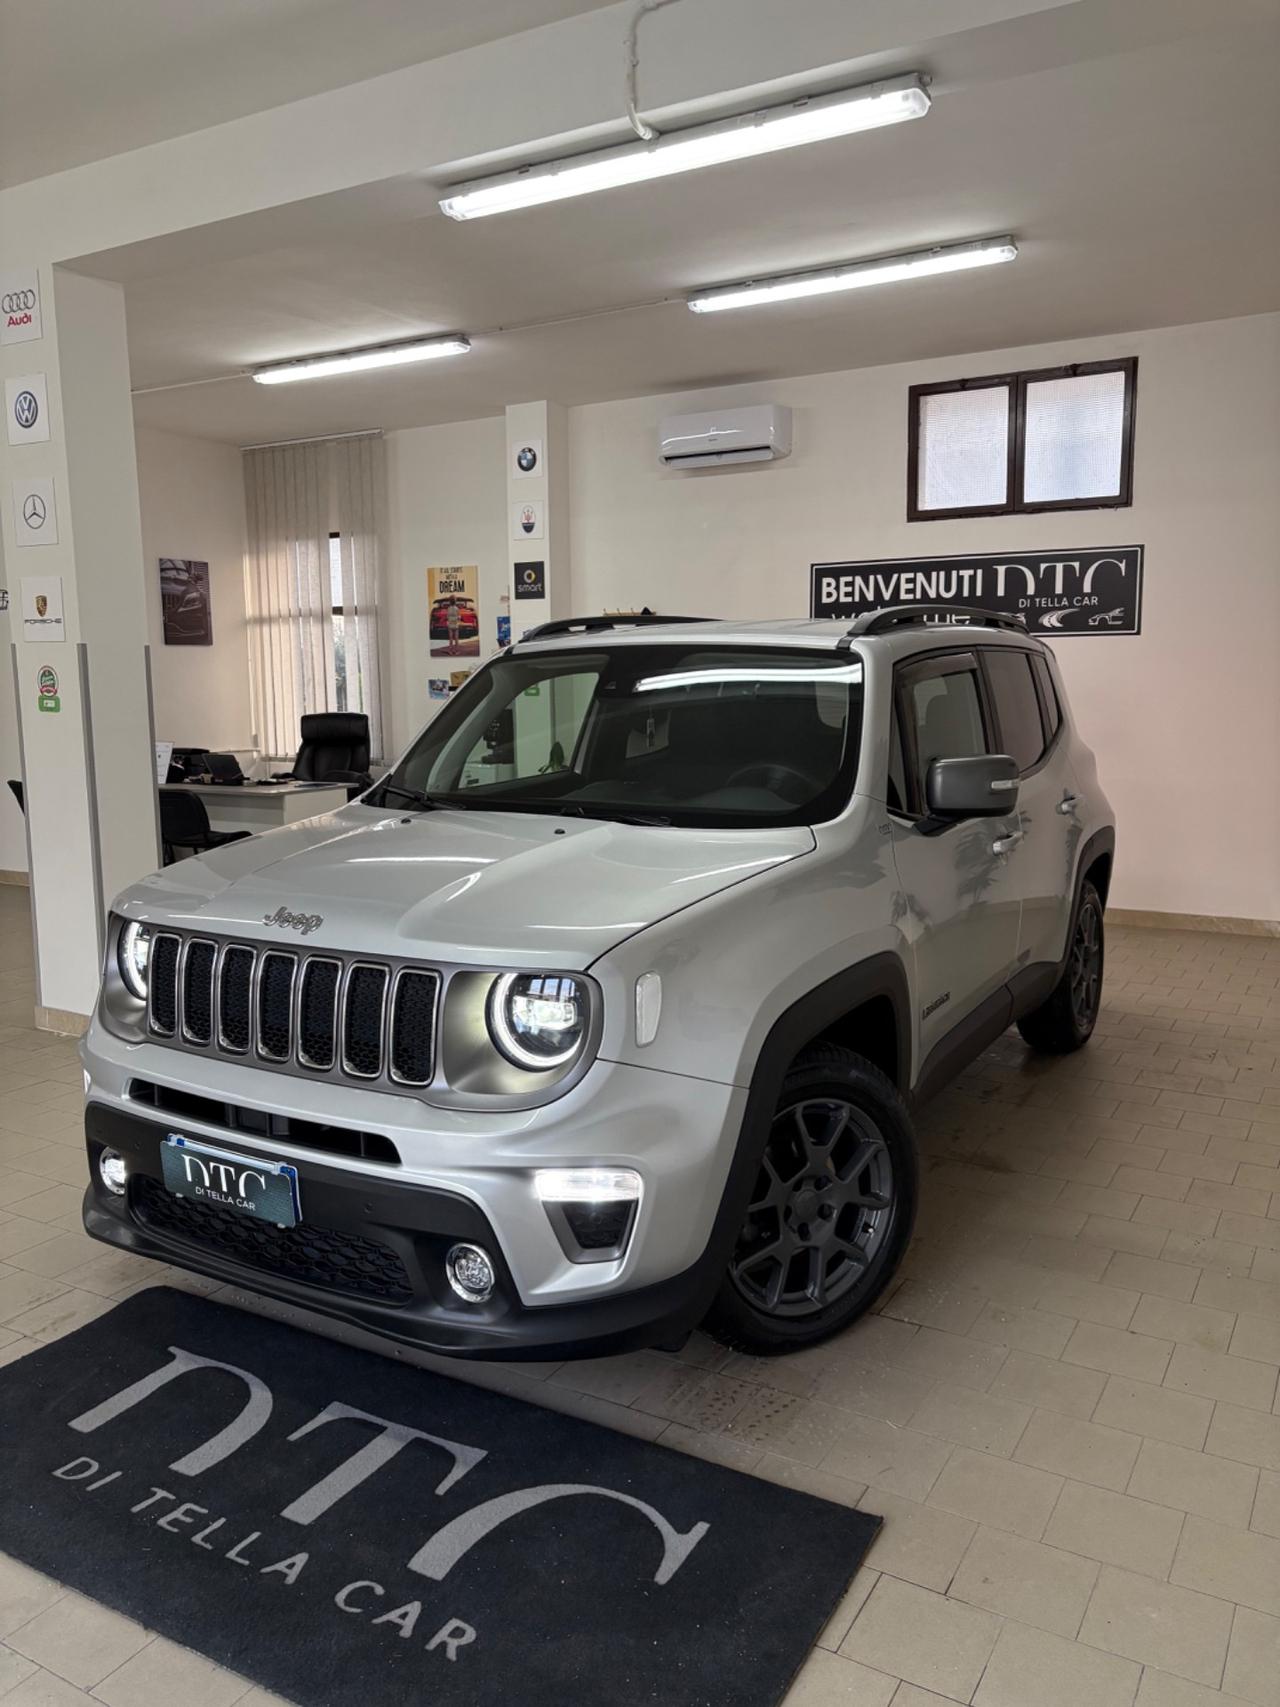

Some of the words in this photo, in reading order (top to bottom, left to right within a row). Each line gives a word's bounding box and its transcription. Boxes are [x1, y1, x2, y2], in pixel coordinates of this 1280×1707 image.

[7, 313, 32, 327] Audi
[439, 579, 465, 593] DREAM
[517, 583, 542, 592] smart
[821, 568, 983, 604] BENVENUTI
[1018, 598, 1031, 608] DI
[1035, 597, 1069, 608] TELLA
[1073, 596, 1099, 606] CAR
[262, 905, 324, 936] Jeep
[195, 1186, 205, 1196] DI
[206, 1189, 235, 1205] TELLA
[235, 1198, 257, 1212] CAR
[51, 1456, 123, 1492] DI
[130, 1486, 310, 1585] TELLA
[334, 1579, 477, 1662] CAR
